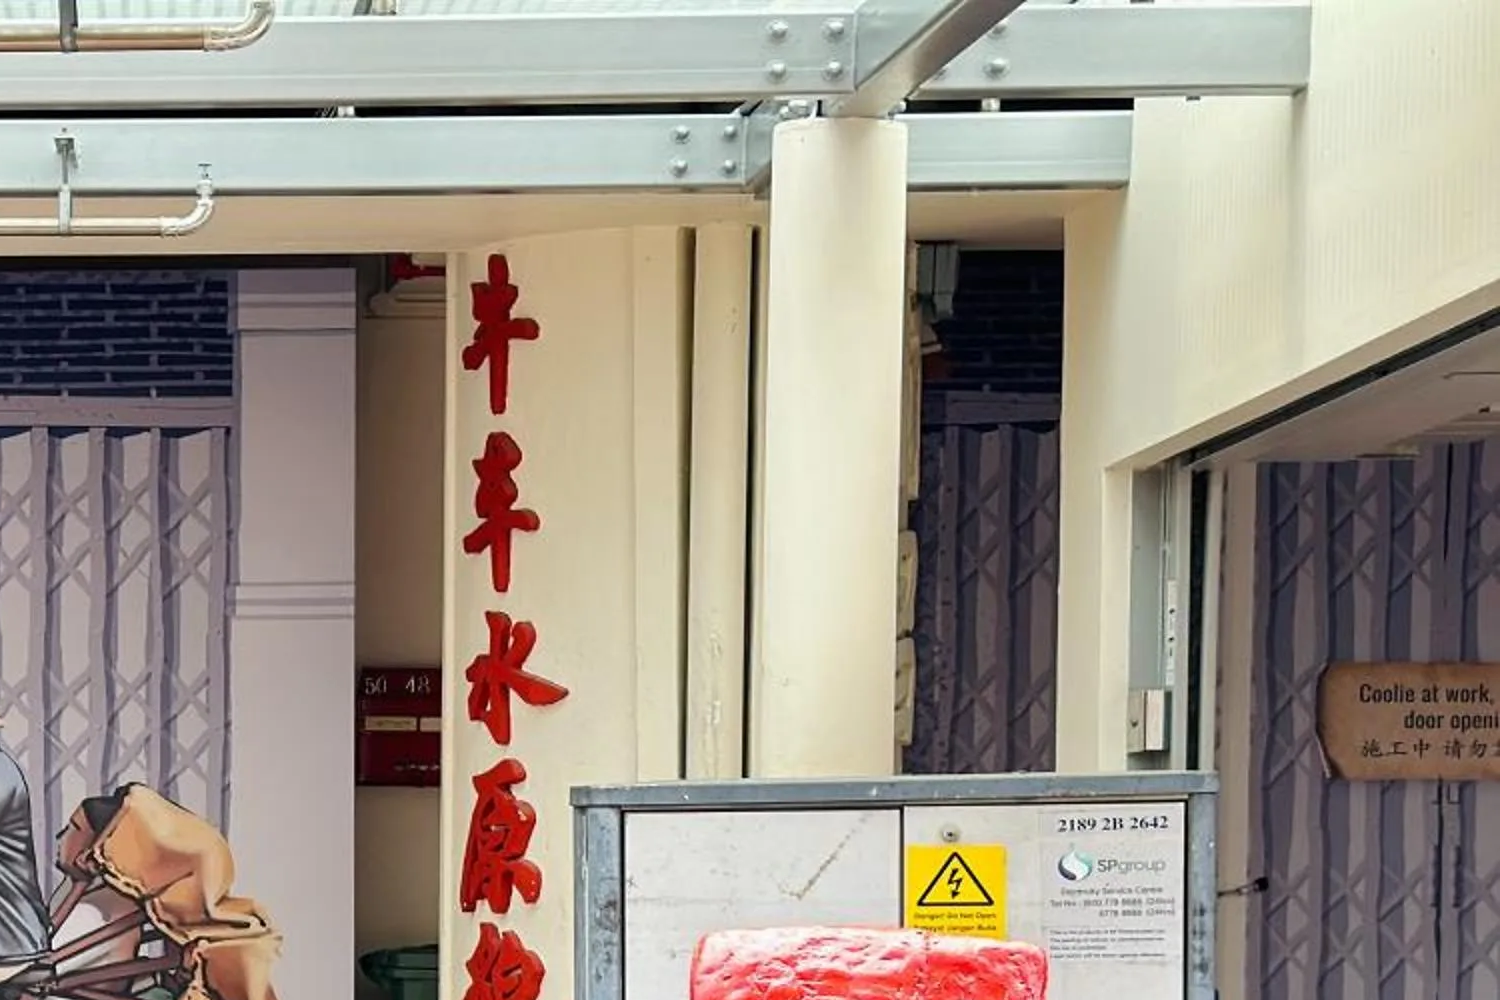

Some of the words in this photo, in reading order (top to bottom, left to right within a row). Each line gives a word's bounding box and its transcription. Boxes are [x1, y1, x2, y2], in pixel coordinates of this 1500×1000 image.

[1359, 682, 1416, 704] Coolie
[1421, 683, 1440, 704] at
[1445, 682, 1495, 706] work,
[1403, 709, 1445, 731] door
[1057, 817, 1097, 833] 2189
[1101, 816, 1125, 831] 2B
[1129, 815, 1169, 830] 2642
[1097, 858, 1167, 875] SPgroup
